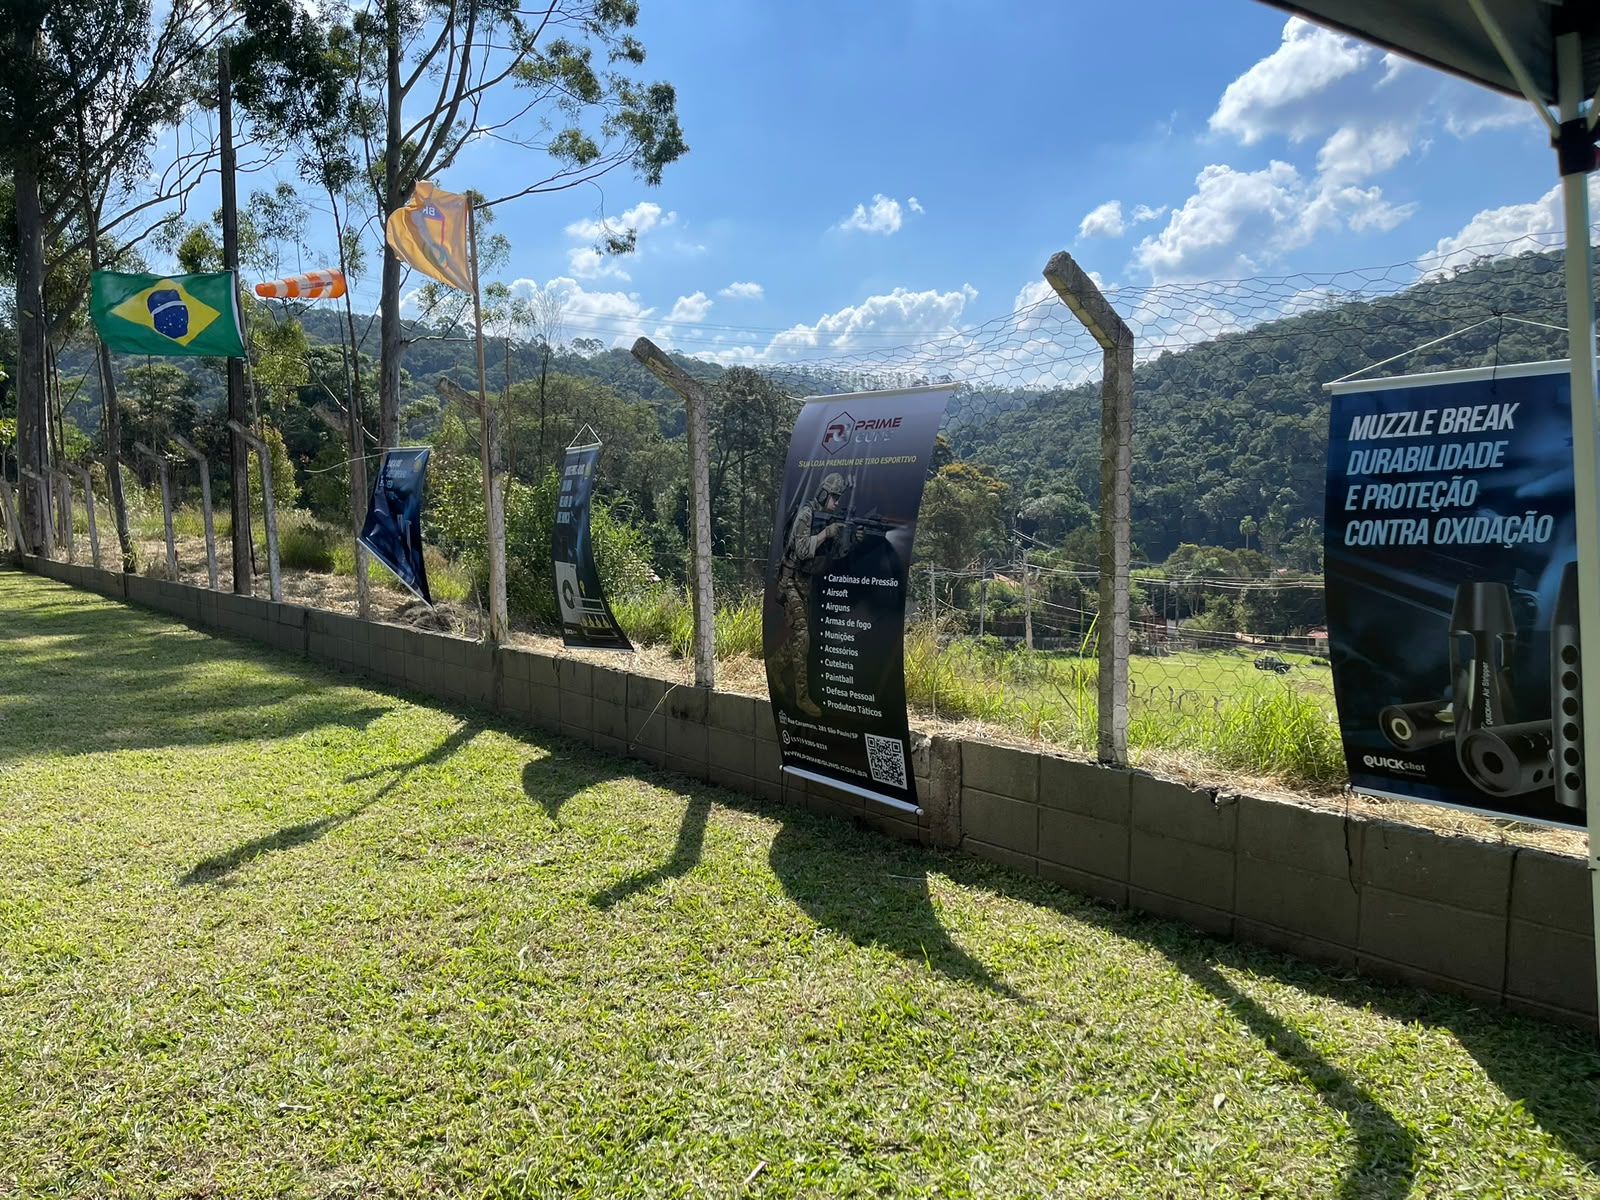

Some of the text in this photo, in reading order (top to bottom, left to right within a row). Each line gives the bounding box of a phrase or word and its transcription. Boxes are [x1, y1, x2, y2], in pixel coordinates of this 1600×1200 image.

[854, 416, 903, 431] PRIME
[1348, 402, 1521, 441] MUZZLE BREAK
[811, 459, 825, 467] LOJA
[864, 457, 880, 465] TIRO
[880, 455, 917, 464] ESPORTIVO
[1346, 440, 1509, 475] DURABILIDADE
[1344, 475, 1478, 512] E PROTEÇÃO
[1344, 510, 1554, 548] CONTRA OXIDAÇÃO
[828, 573, 898, 588] Carabinas de Pressão
[826, 588, 848, 598] Airsoft
[825, 602, 850, 613] Airguns
[825, 616, 872, 630] Armas de fogo
[824, 630, 855, 642] Munições
[824, 644, 859, 657] Acessórios
[824, 658, 854, 670] Cutelaria
[825, 672, 854, 685] Paintball
[826, 686, 875, 702] Defesa Pessoal
[827, 700, 882, 718] Produtos Táticos
[1363, 755, 1426, 772] QUICKshot
